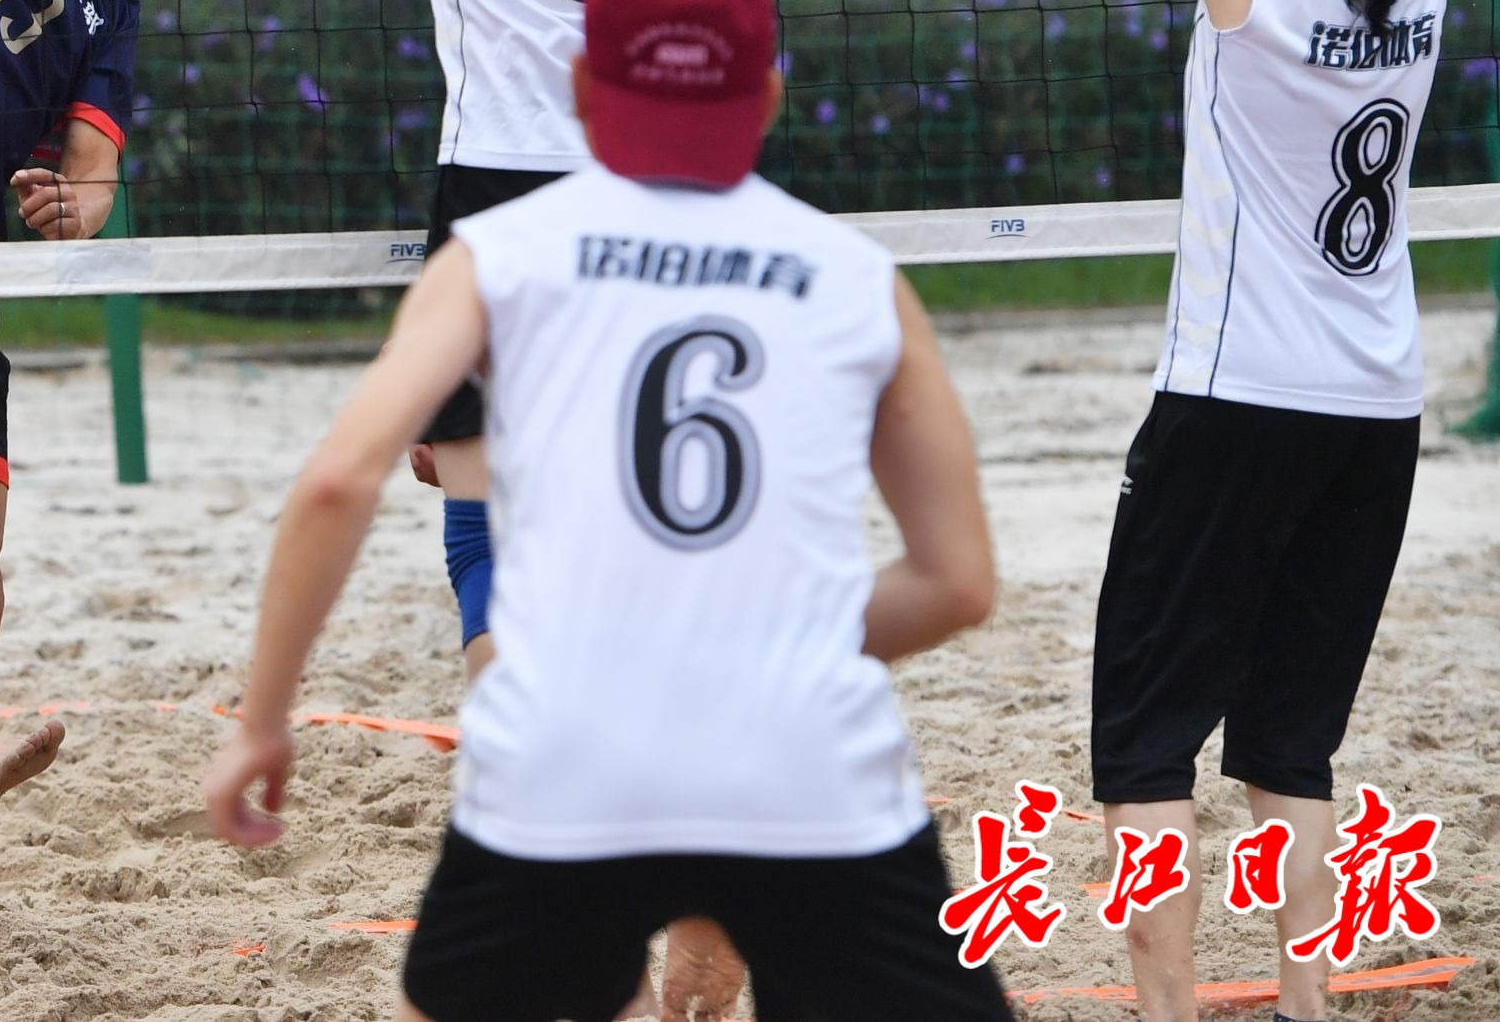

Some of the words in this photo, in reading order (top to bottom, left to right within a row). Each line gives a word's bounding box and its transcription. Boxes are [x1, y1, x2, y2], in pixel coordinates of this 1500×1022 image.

[991, 218, 1026, 233] FIVB
[1313, 97, 1411, 276] 8
[616, 314, 766, 554] 6
